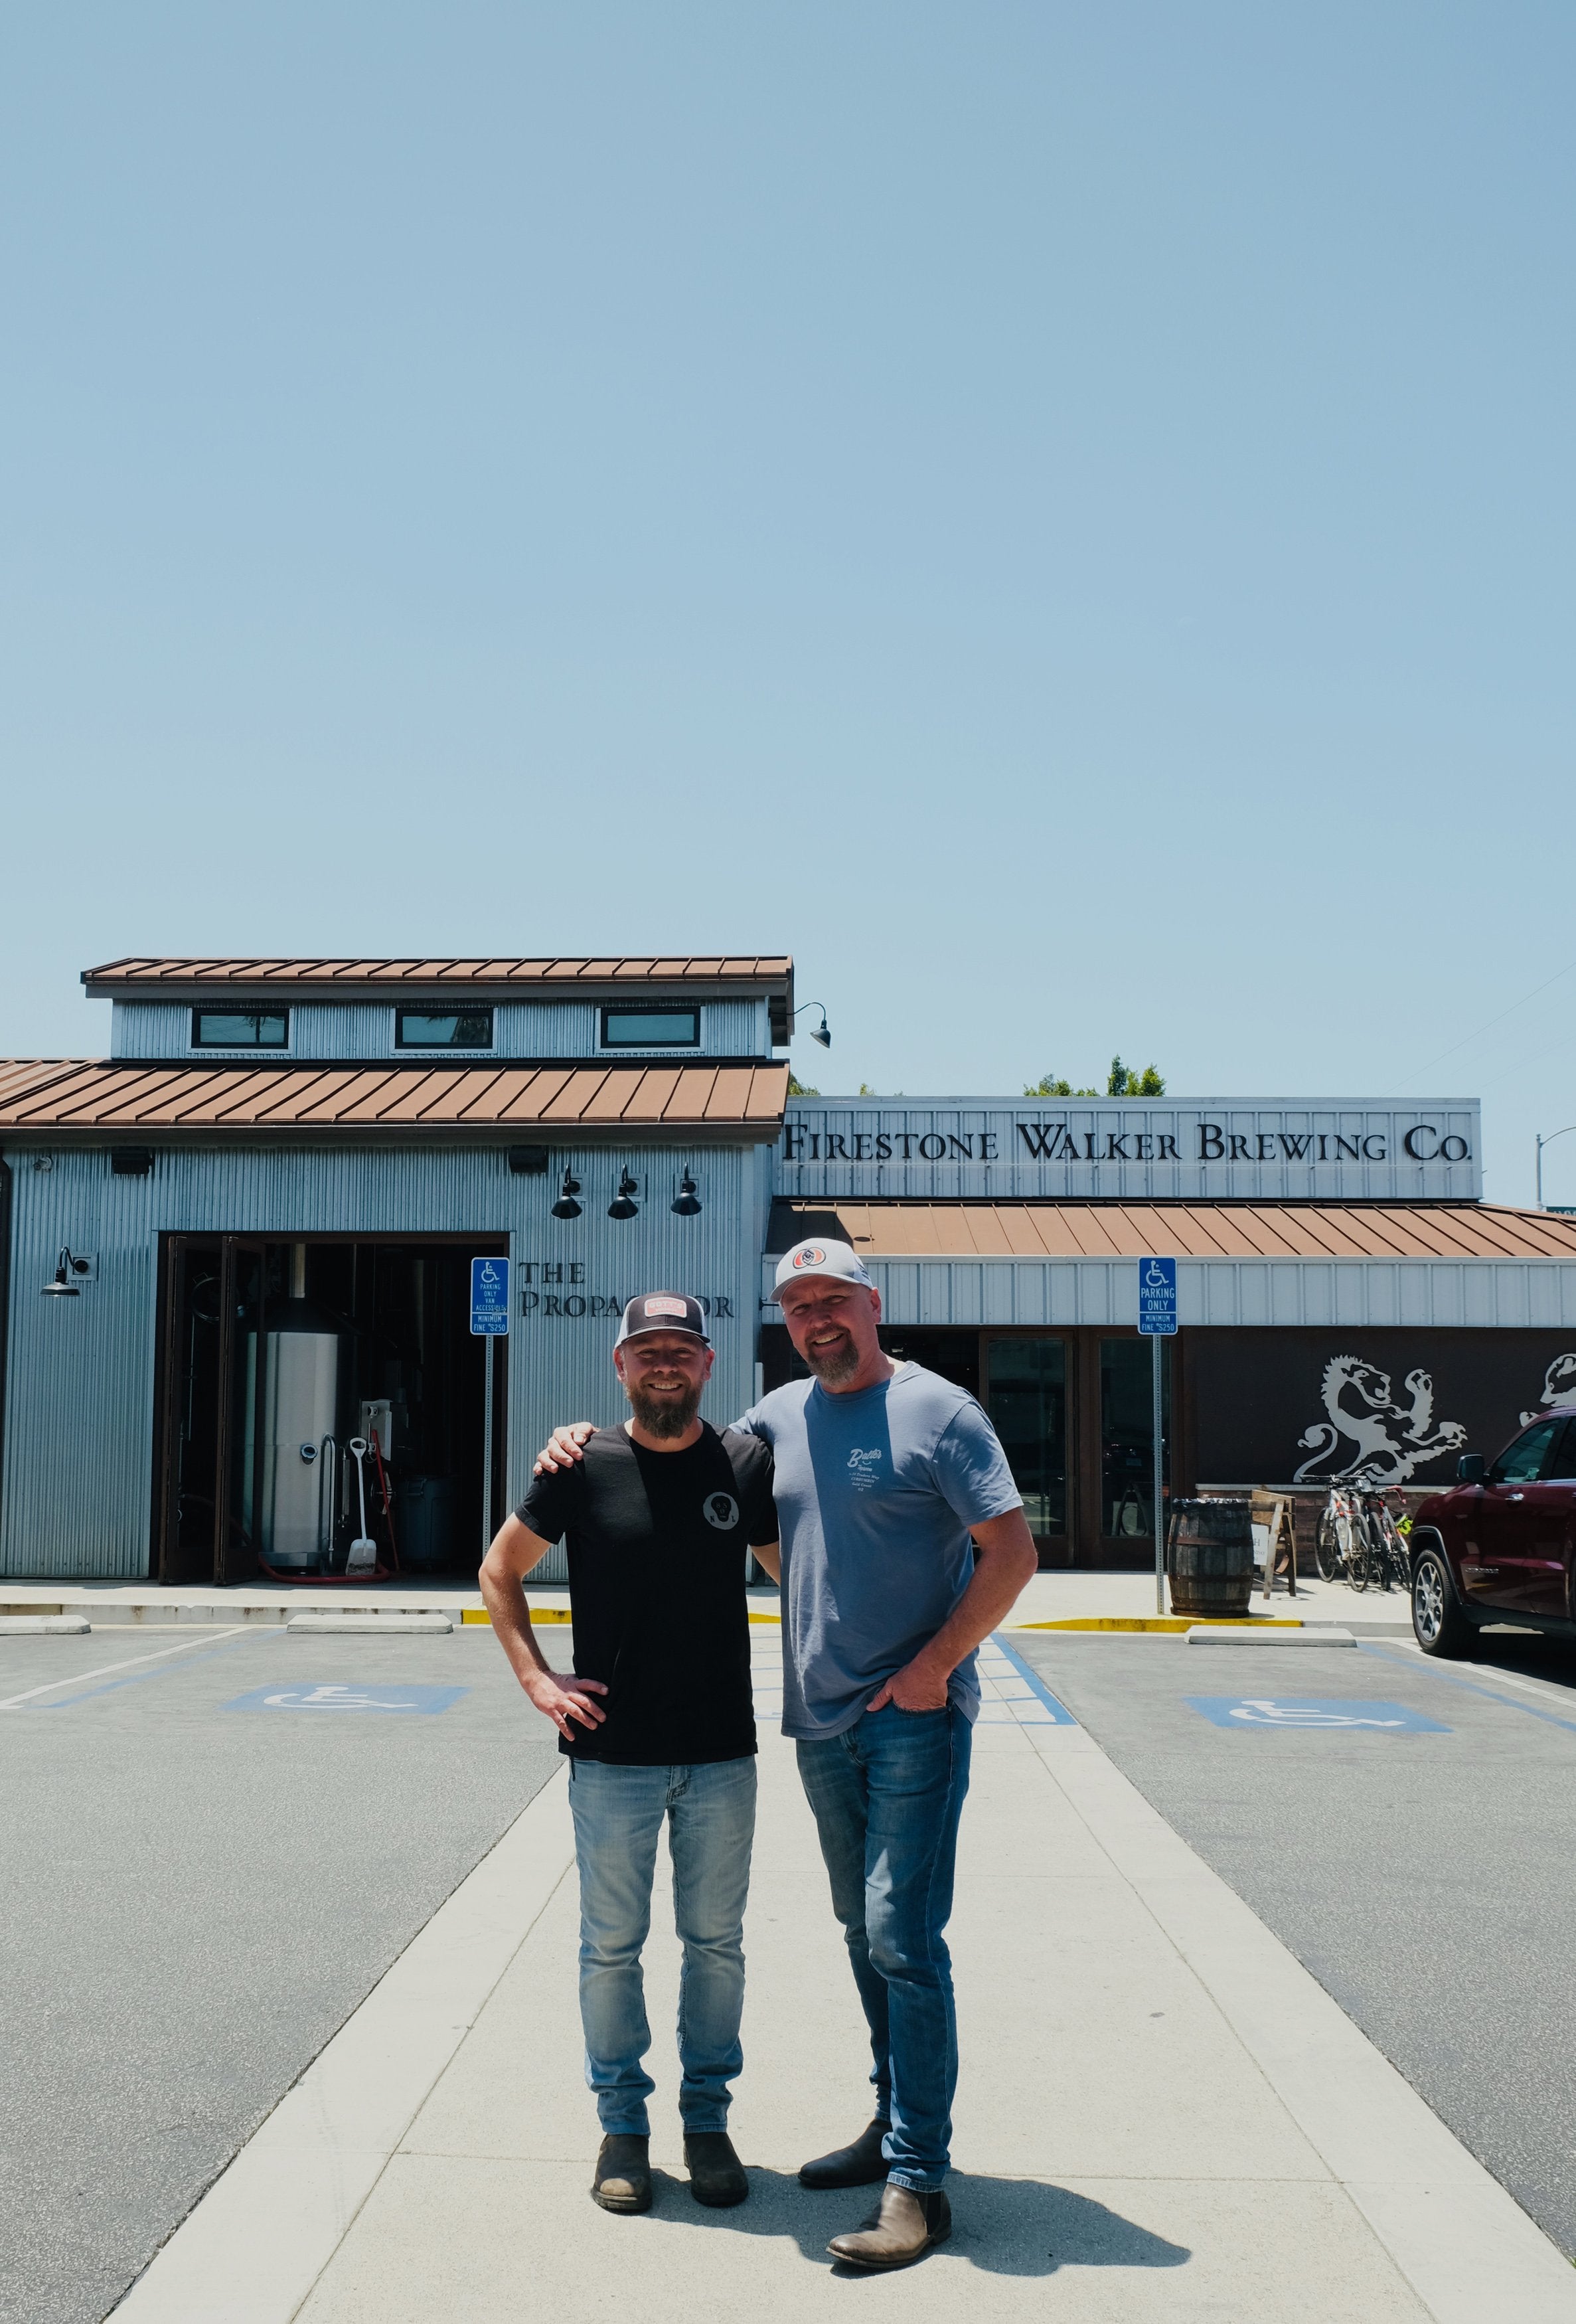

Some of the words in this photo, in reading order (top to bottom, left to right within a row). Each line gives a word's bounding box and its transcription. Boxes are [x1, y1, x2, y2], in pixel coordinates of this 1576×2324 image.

[782, 1123, 998, 1161] FIRESTONE
[1016, 1123, 1182, 1161] WALKER
[1197, 1123, 1387, 1161] BREWING
[519, 1262, 586, 1284] THE
[1141, 1287, 1175, 1299] PARKING
[1147, 1299, 1168, 1311] ONLY
[477, 1315, 502, 1323] MINIMUM
[473, 1323, 486, 1332] FINE
